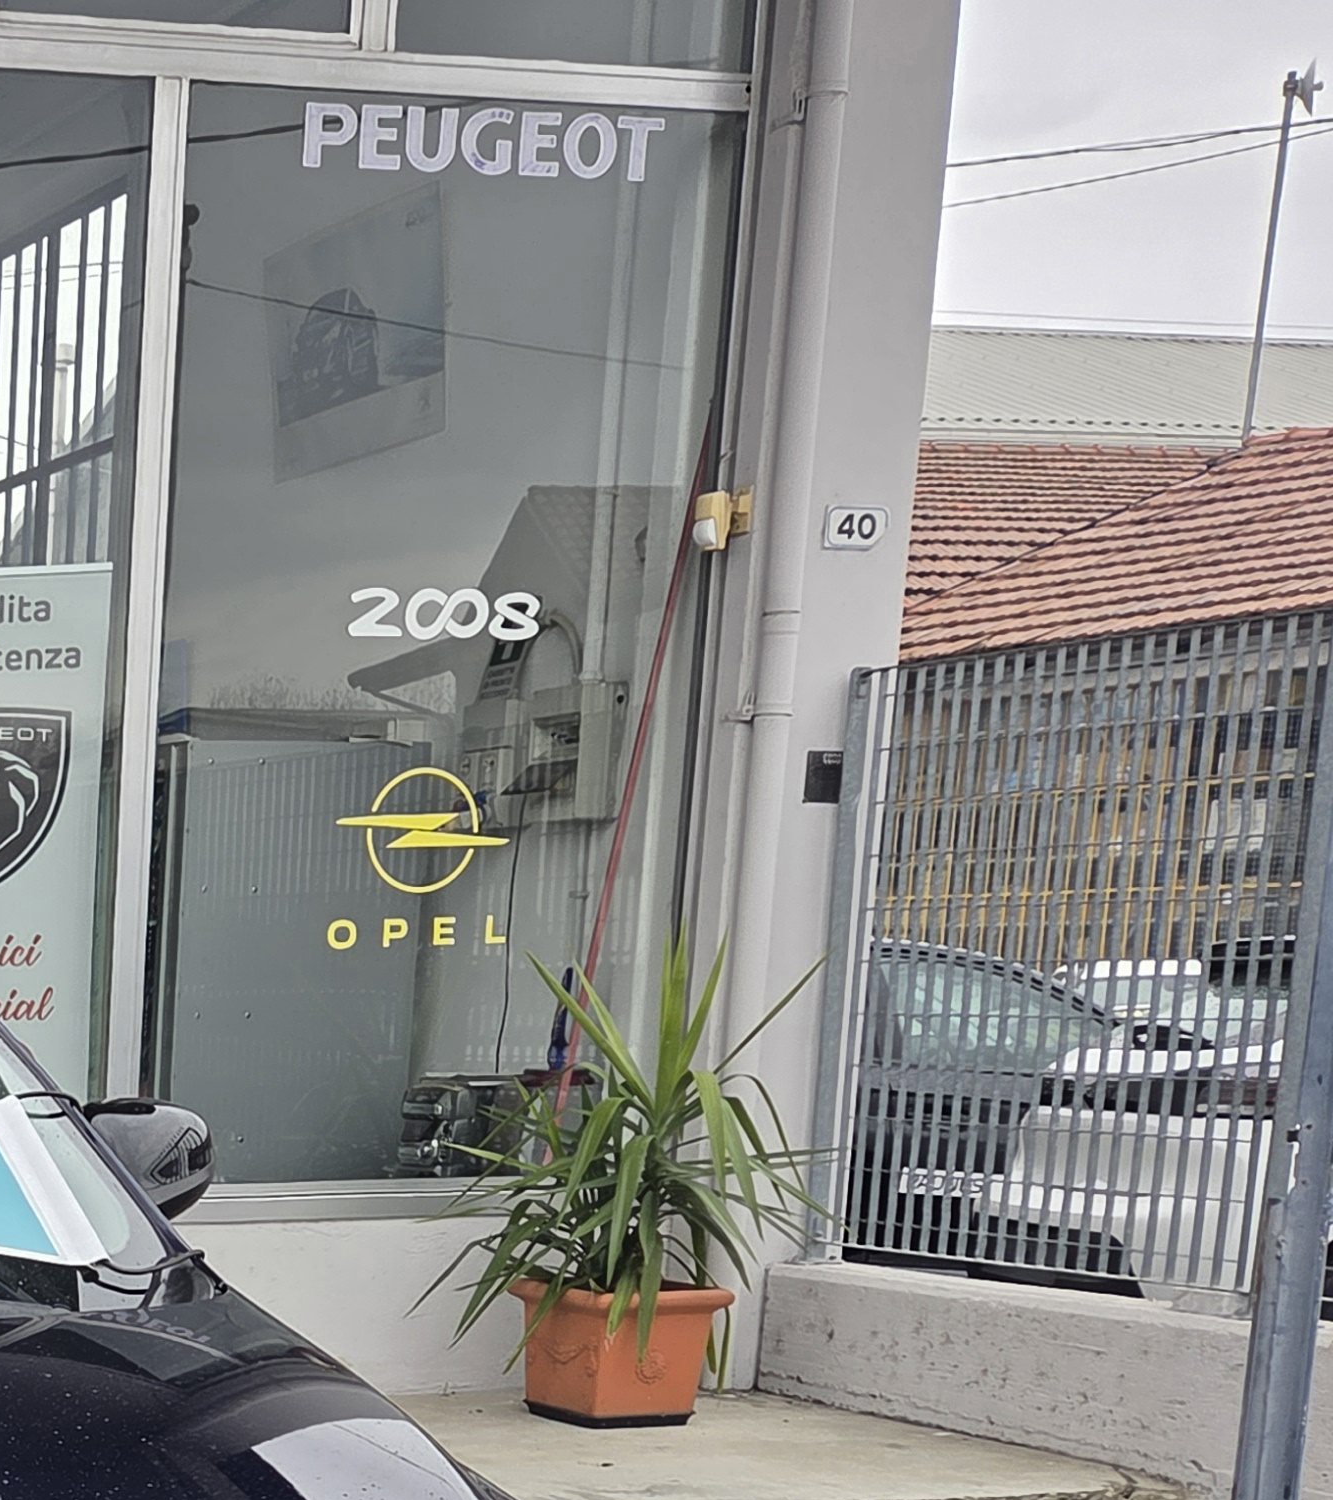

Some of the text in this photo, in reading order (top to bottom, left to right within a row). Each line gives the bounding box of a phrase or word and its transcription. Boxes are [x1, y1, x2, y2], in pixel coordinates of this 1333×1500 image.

[302, 101, 666, 182] PEUGEOT
[837, 513, 877, 540] 40
[347, 587, 541, 641] 2008
[326, 914, 507, 950] OPEL
